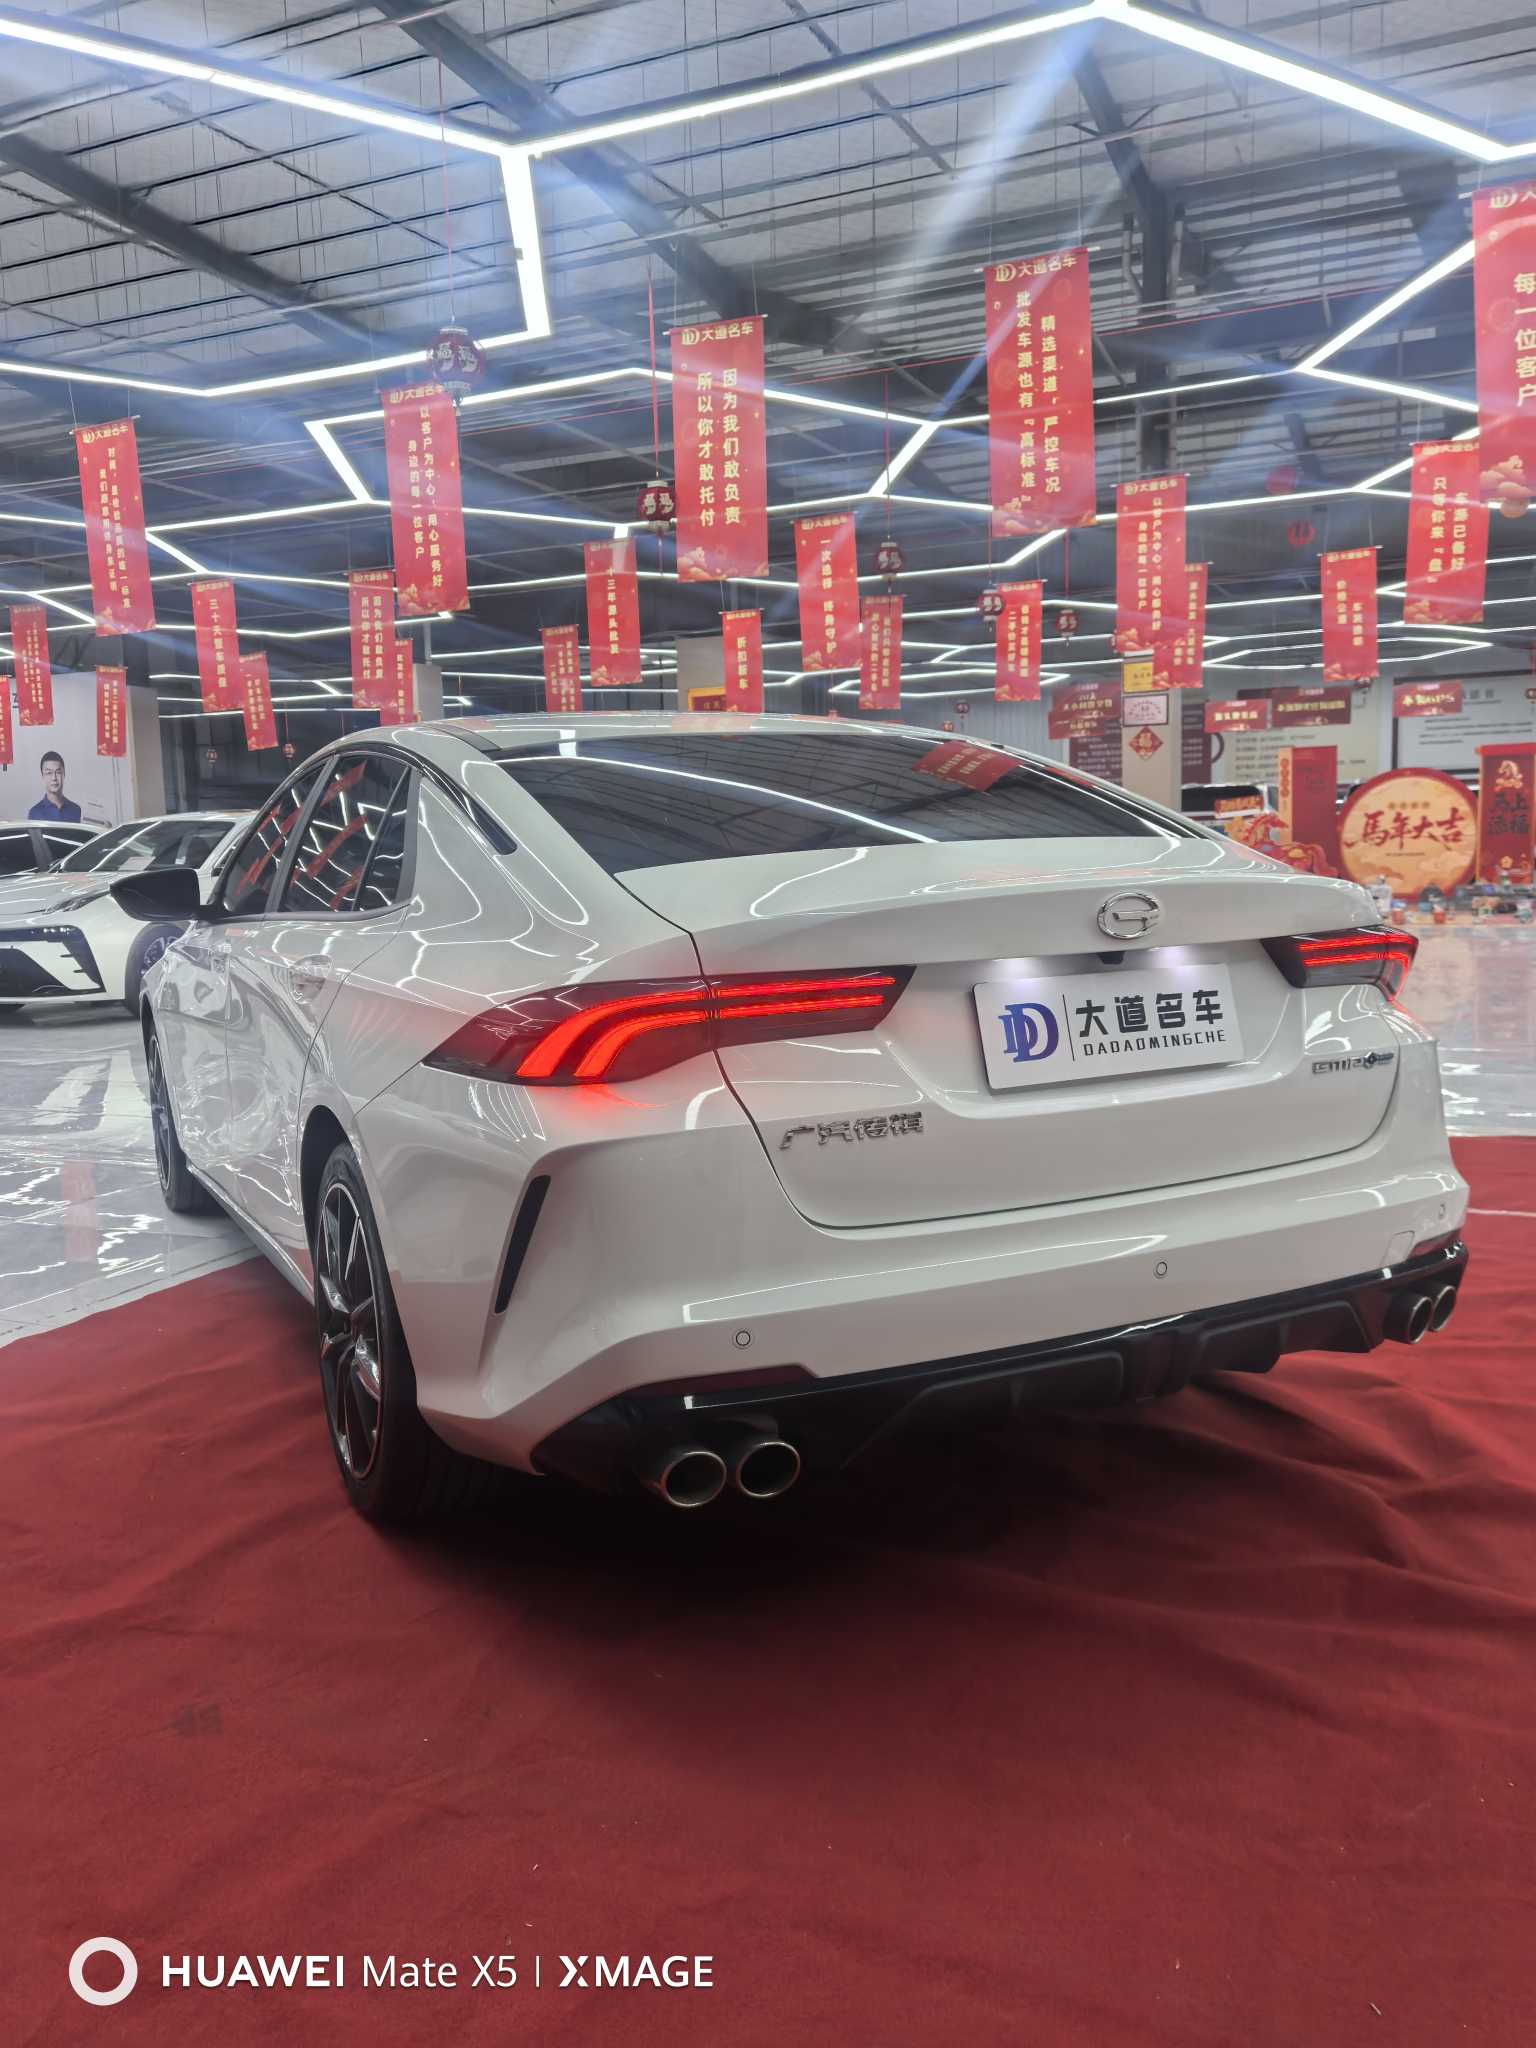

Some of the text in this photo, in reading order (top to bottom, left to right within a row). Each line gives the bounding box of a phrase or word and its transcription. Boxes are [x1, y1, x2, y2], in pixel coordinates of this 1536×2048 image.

[1018, 255, 1077, 278] 大道名车
[701, 321, 753, 342] 大道名车
[1040, 315, 1061, 493] 精选渠道，严控车况
[697, 371, 714, 528] 所以你才敢托付
[722, 368, 741, 525] 因为我们敢负责
[407, 439, 425, 561] 身边的每一位客户
[1075, 989, 1225, 1038] 大道名车
[1083, 1029, 1227, 1057] DADAOMINGCHE
[779, 1111, 924, 1150] 广汽传祺
